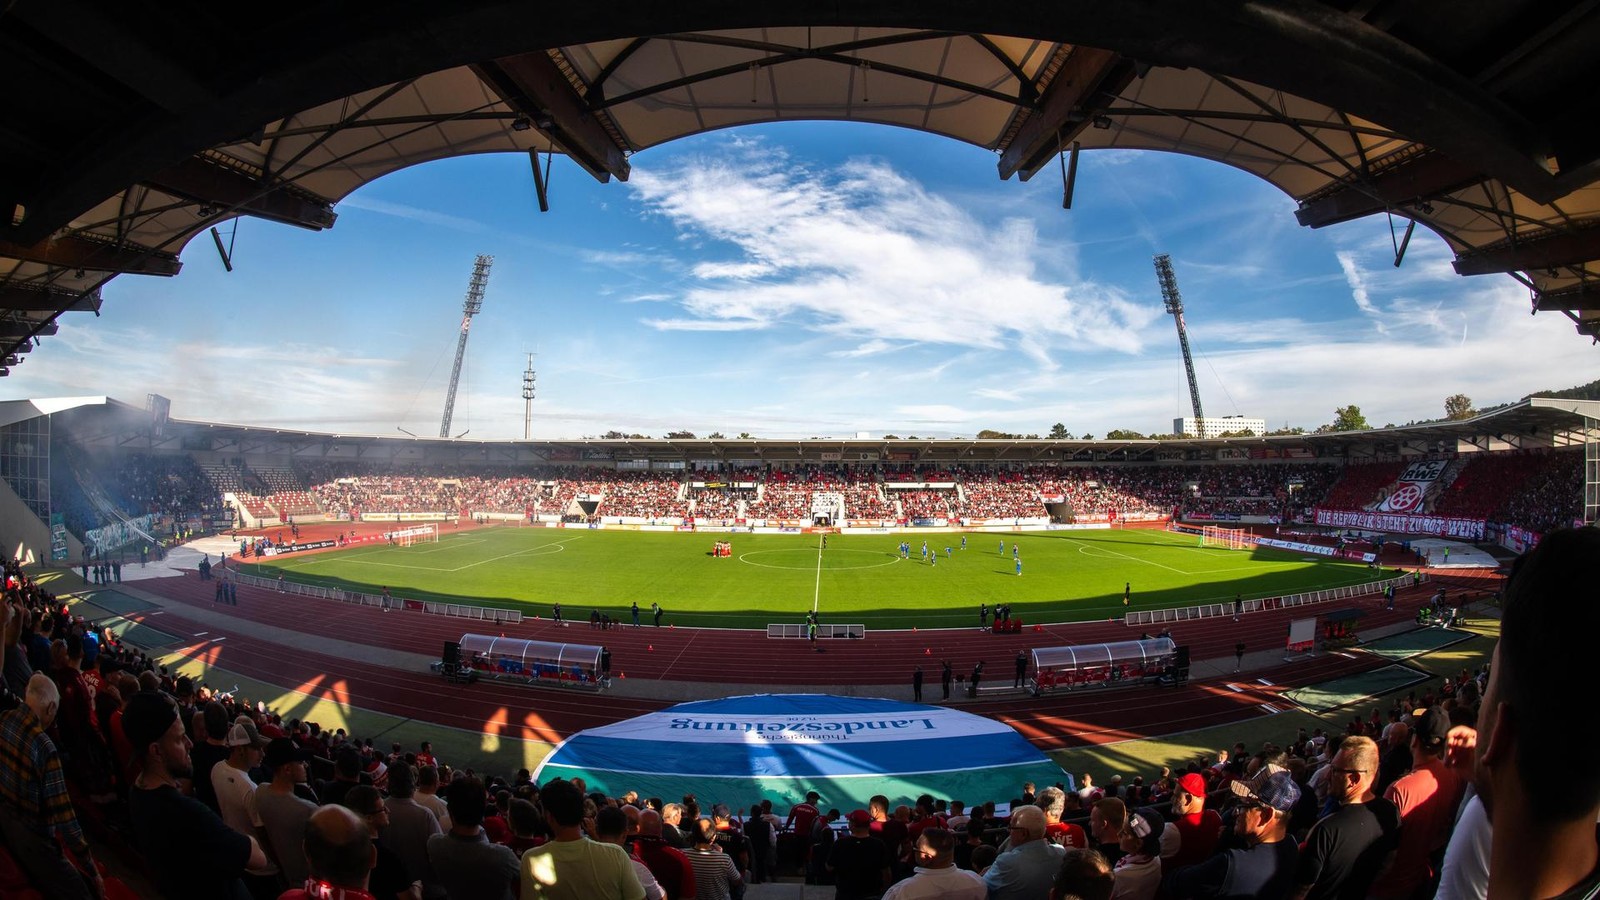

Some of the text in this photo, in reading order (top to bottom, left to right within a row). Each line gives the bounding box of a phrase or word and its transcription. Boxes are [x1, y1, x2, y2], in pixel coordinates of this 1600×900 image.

[1318, 511, 1331, 524] DIE
[1376, 515, 1407, 532] STEHT
[1408, 517, 1422, 532] ZU
[671, 717, 937, 735] Landeszeitung
